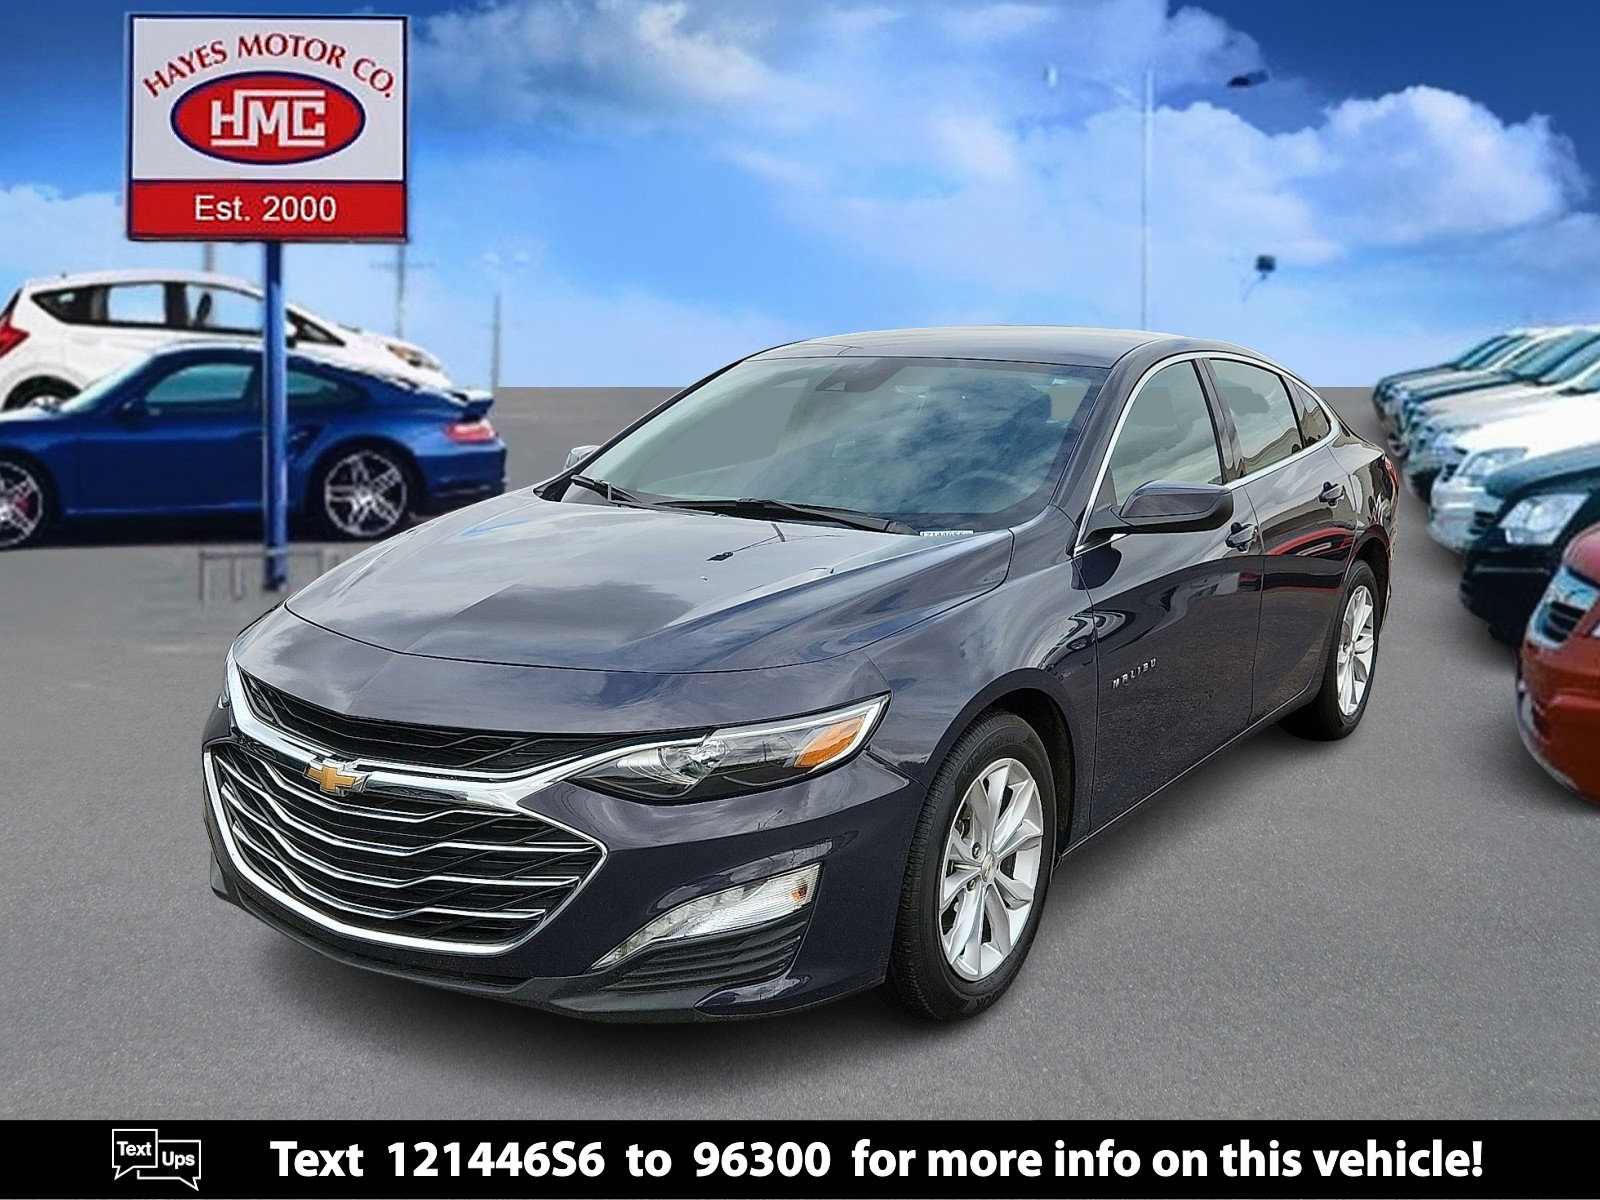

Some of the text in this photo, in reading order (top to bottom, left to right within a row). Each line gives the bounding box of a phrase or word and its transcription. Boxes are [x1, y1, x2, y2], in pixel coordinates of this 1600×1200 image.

[143, 33, 394, 98] HAYES MOTOR CO.
[210, 89, 325, 147] HMC
[195, 195, 337, 222] Est. 2000
[1112, 657, 1157, 690] MALIBU
